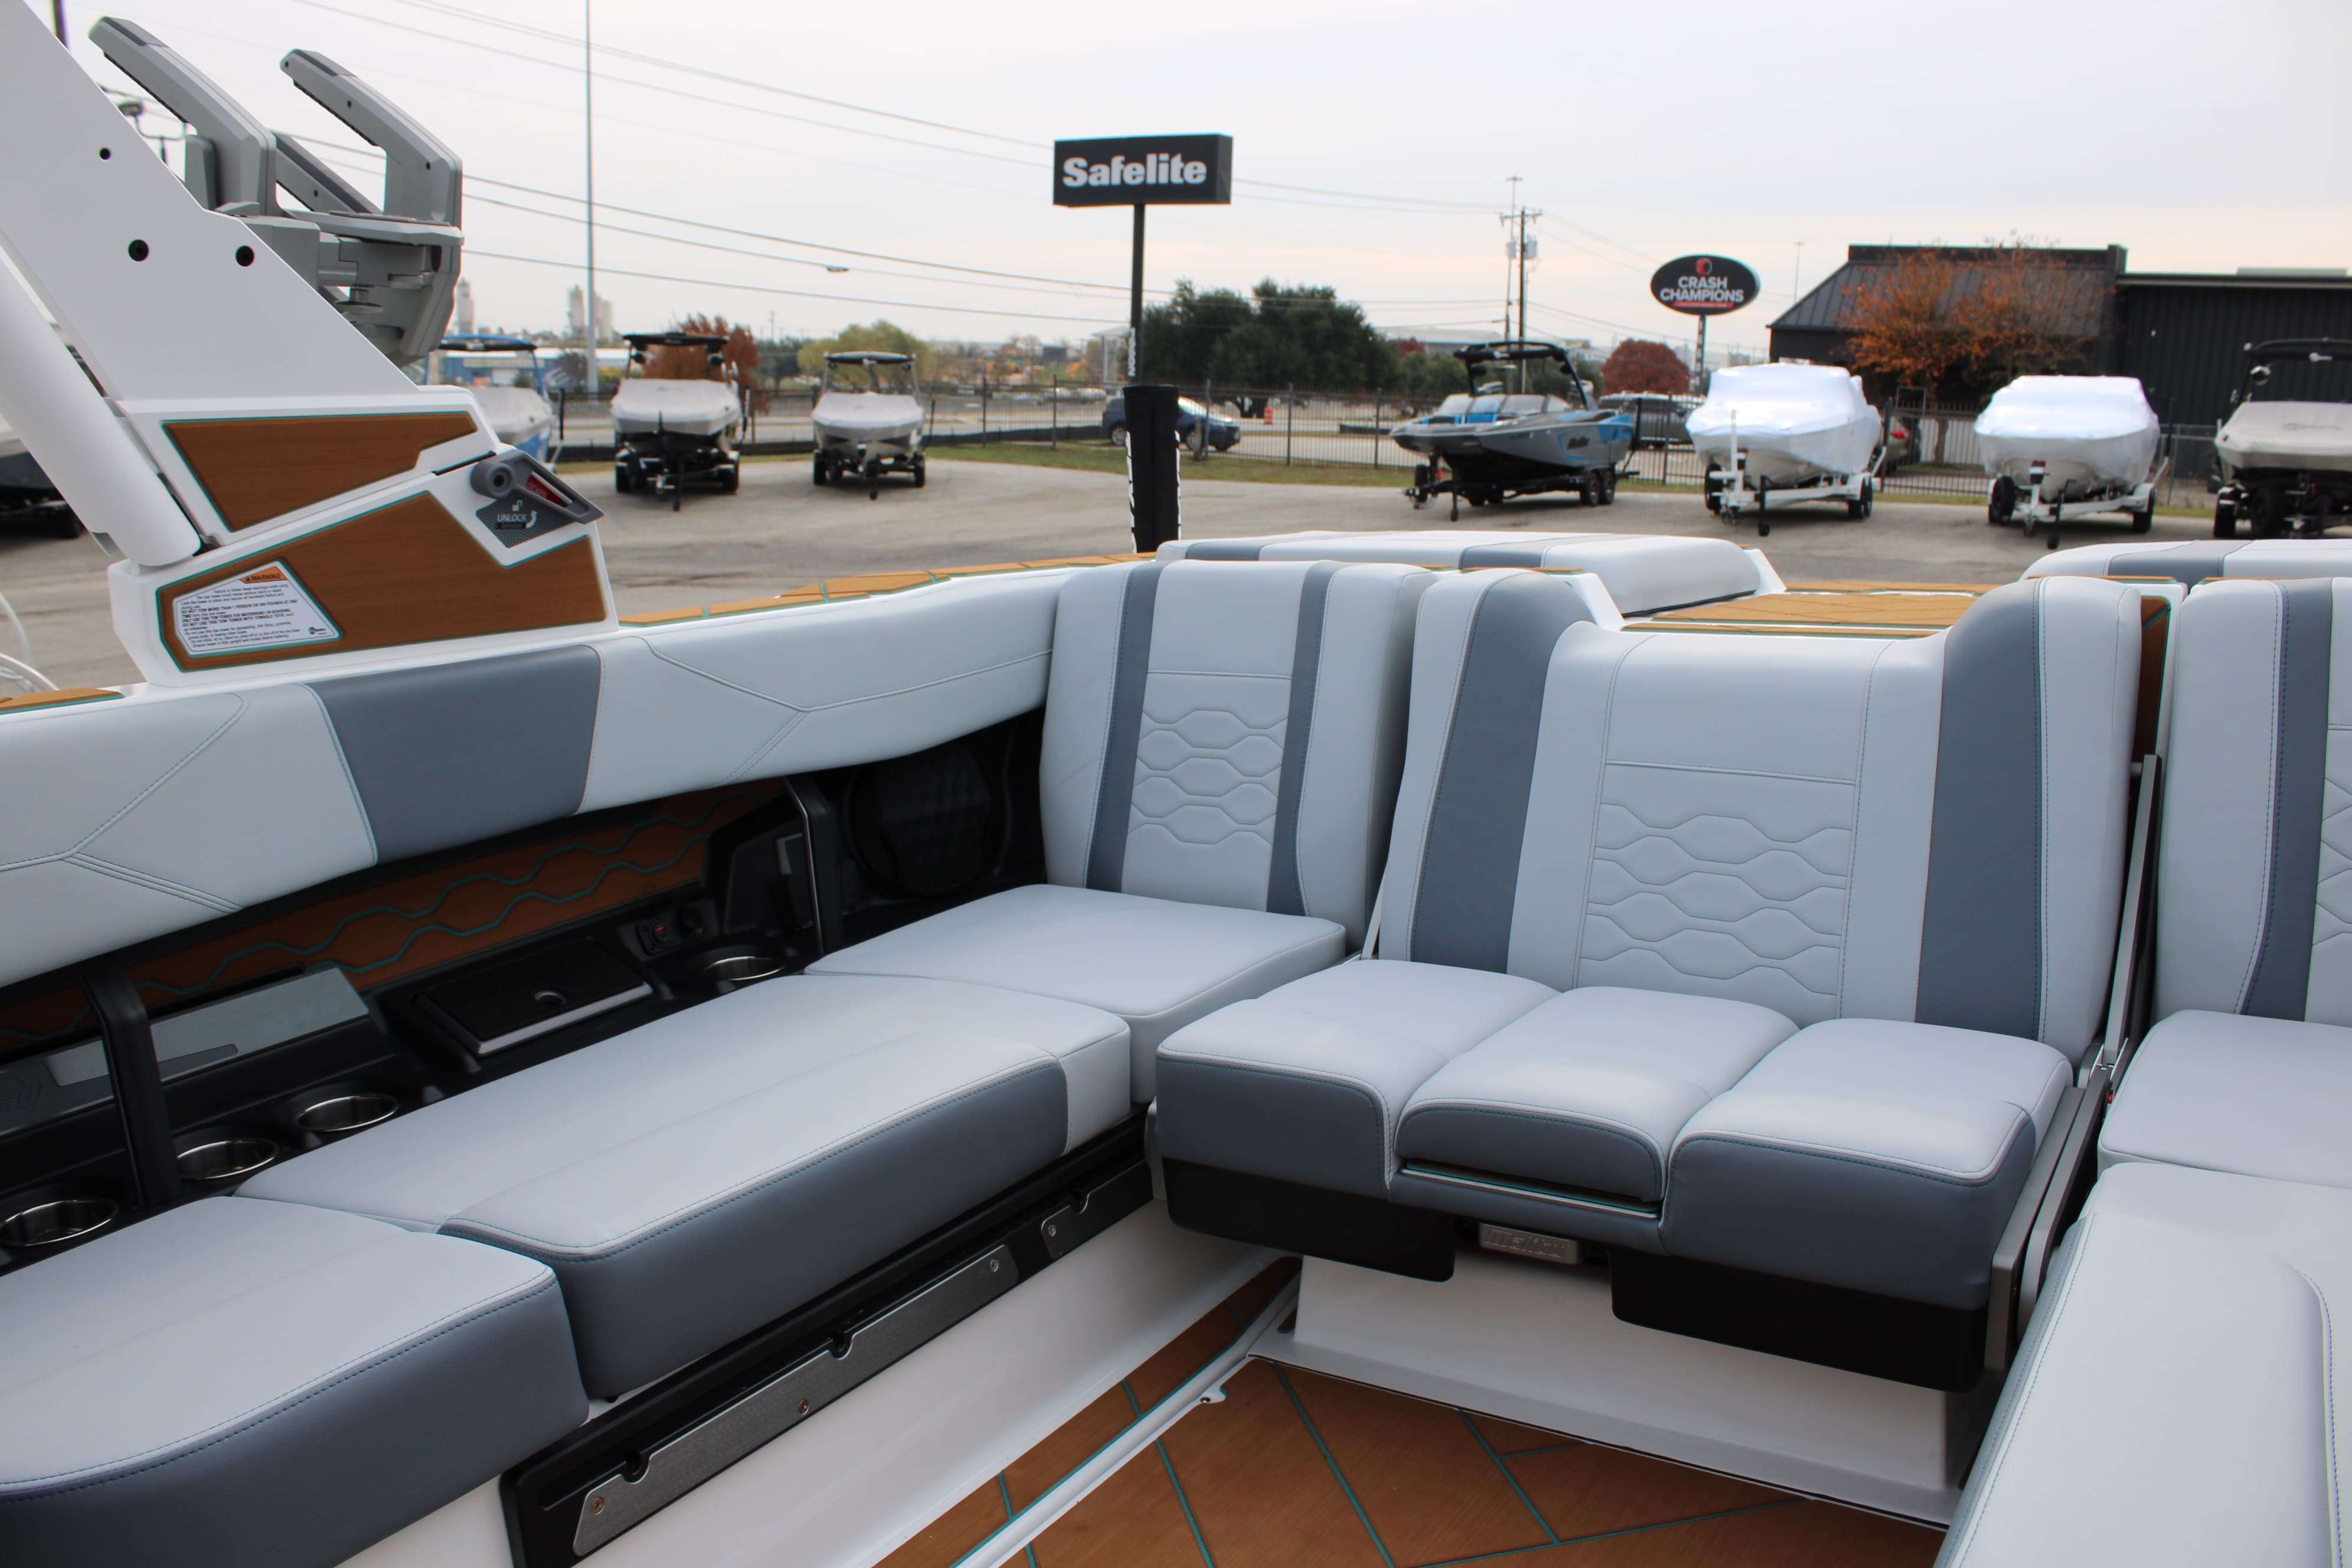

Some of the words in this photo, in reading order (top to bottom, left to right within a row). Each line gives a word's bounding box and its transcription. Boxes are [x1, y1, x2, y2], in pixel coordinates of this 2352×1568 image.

[1063, 153, 1207, 187] Safelite
[1678, 276, 1727, 289] CRASH
[1660, 288, 1744, 303] CHAMPIONS
[498, 514, 527, 522] UNLOCK
